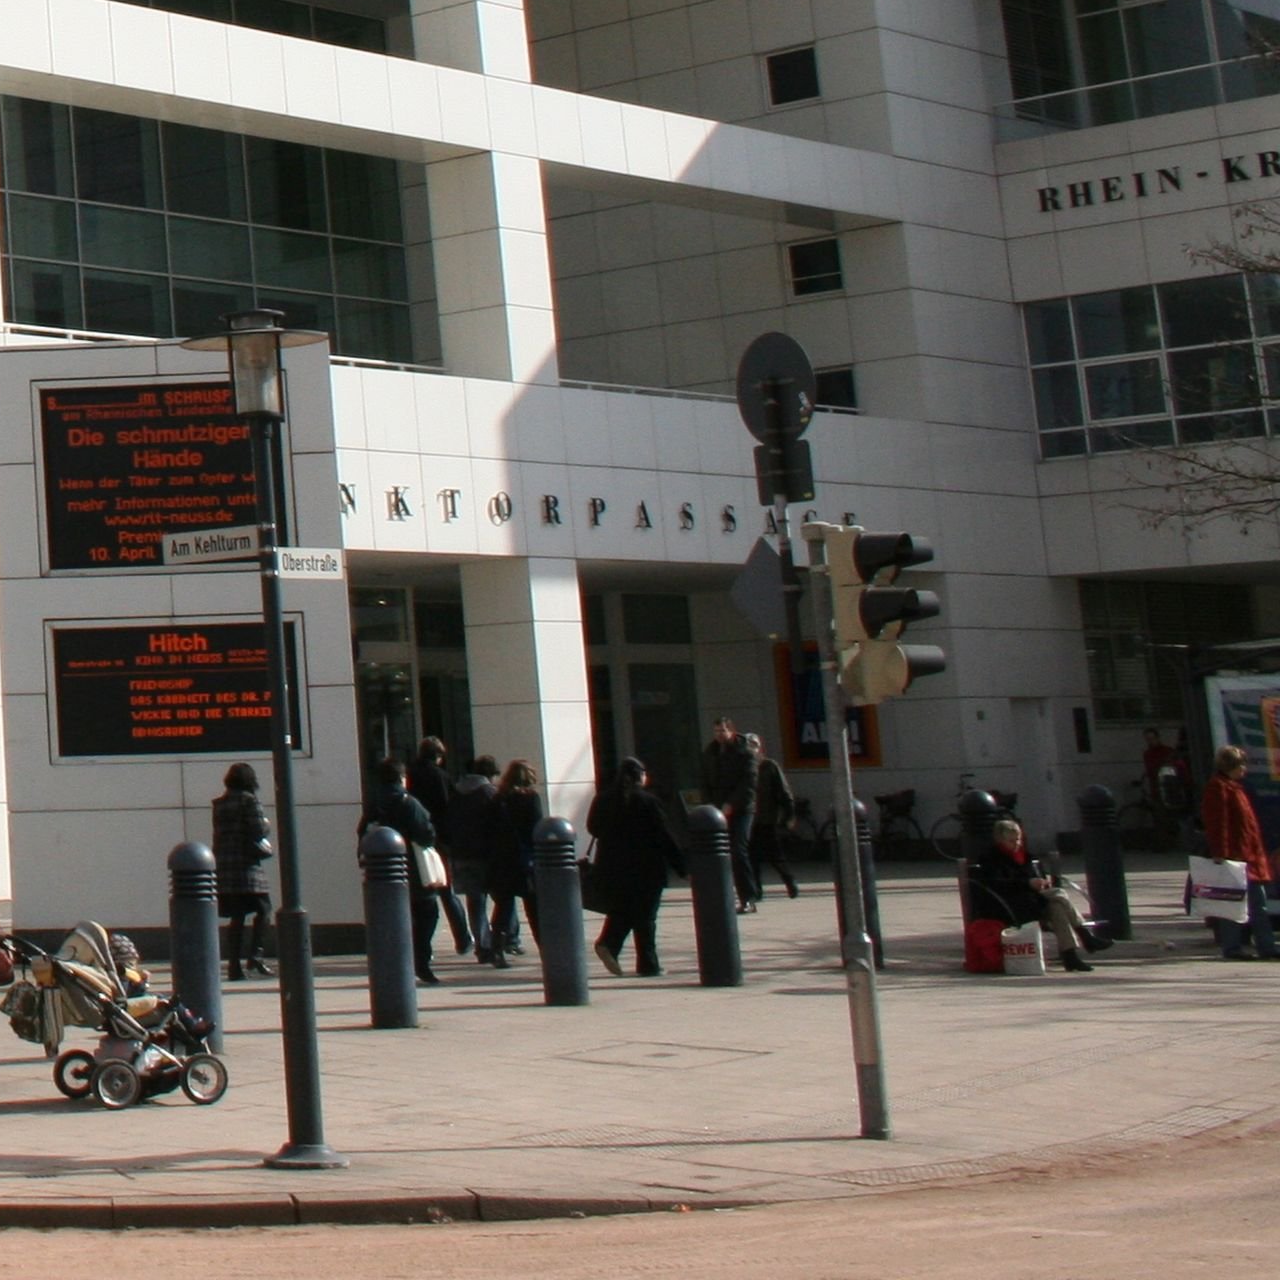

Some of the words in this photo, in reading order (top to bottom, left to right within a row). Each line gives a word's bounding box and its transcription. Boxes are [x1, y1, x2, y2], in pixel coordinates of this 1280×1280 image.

[67, 428, 105, 447] Die
[133, 450, 203, 468] Hände
[99, 477, 121, 489] der
[67, 499, 107, 513] mehr
[115, 496, 220, 511] Informationen
[119, 545, 155, 561] April
[171, 539, 190, 557] Am
[195, 534, 251, 554] Kehlturm
[282, 553, 338, 571] Oberstraße
[149, 633, 208, 652] Hitch
[801, 719, 861, 744] ALI
[1001, 942, 1036, 956] REWE
